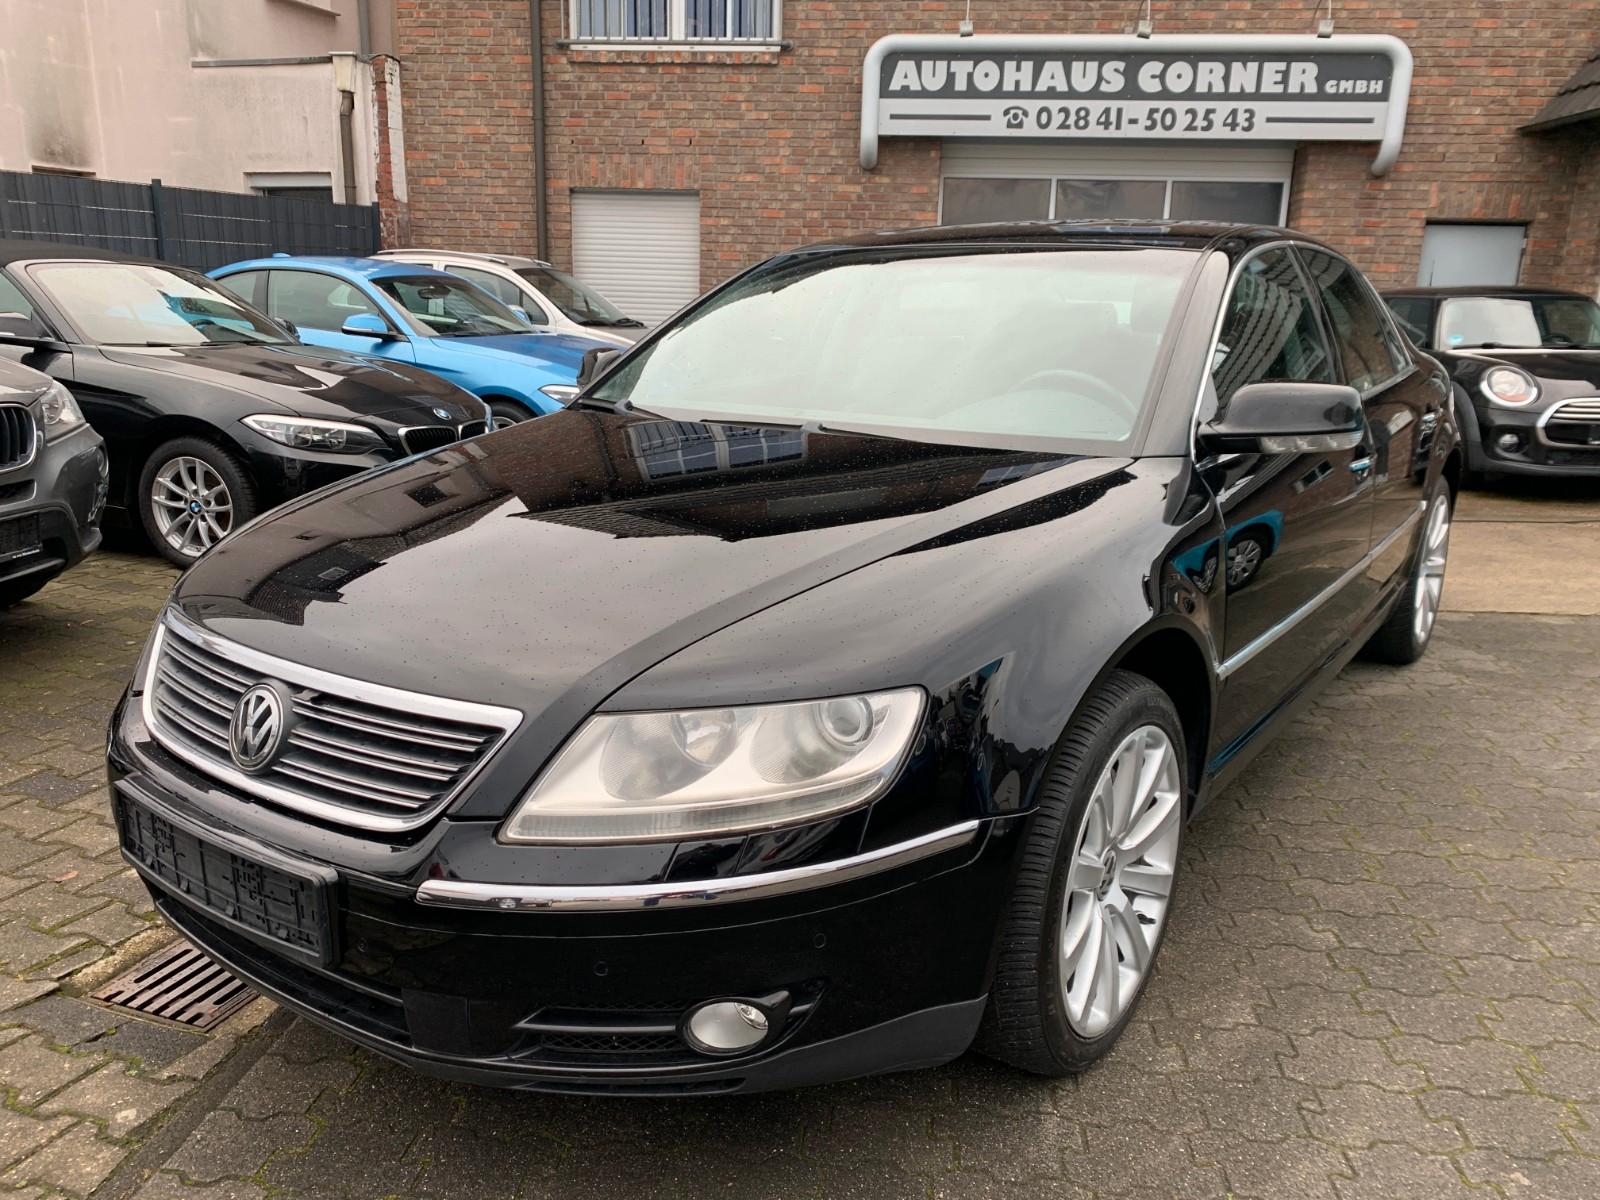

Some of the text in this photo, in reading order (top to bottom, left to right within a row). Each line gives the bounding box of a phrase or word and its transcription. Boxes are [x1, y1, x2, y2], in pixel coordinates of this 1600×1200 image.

[888, 60, 1384, 94] AUTOHAUS CORNER GMBH
